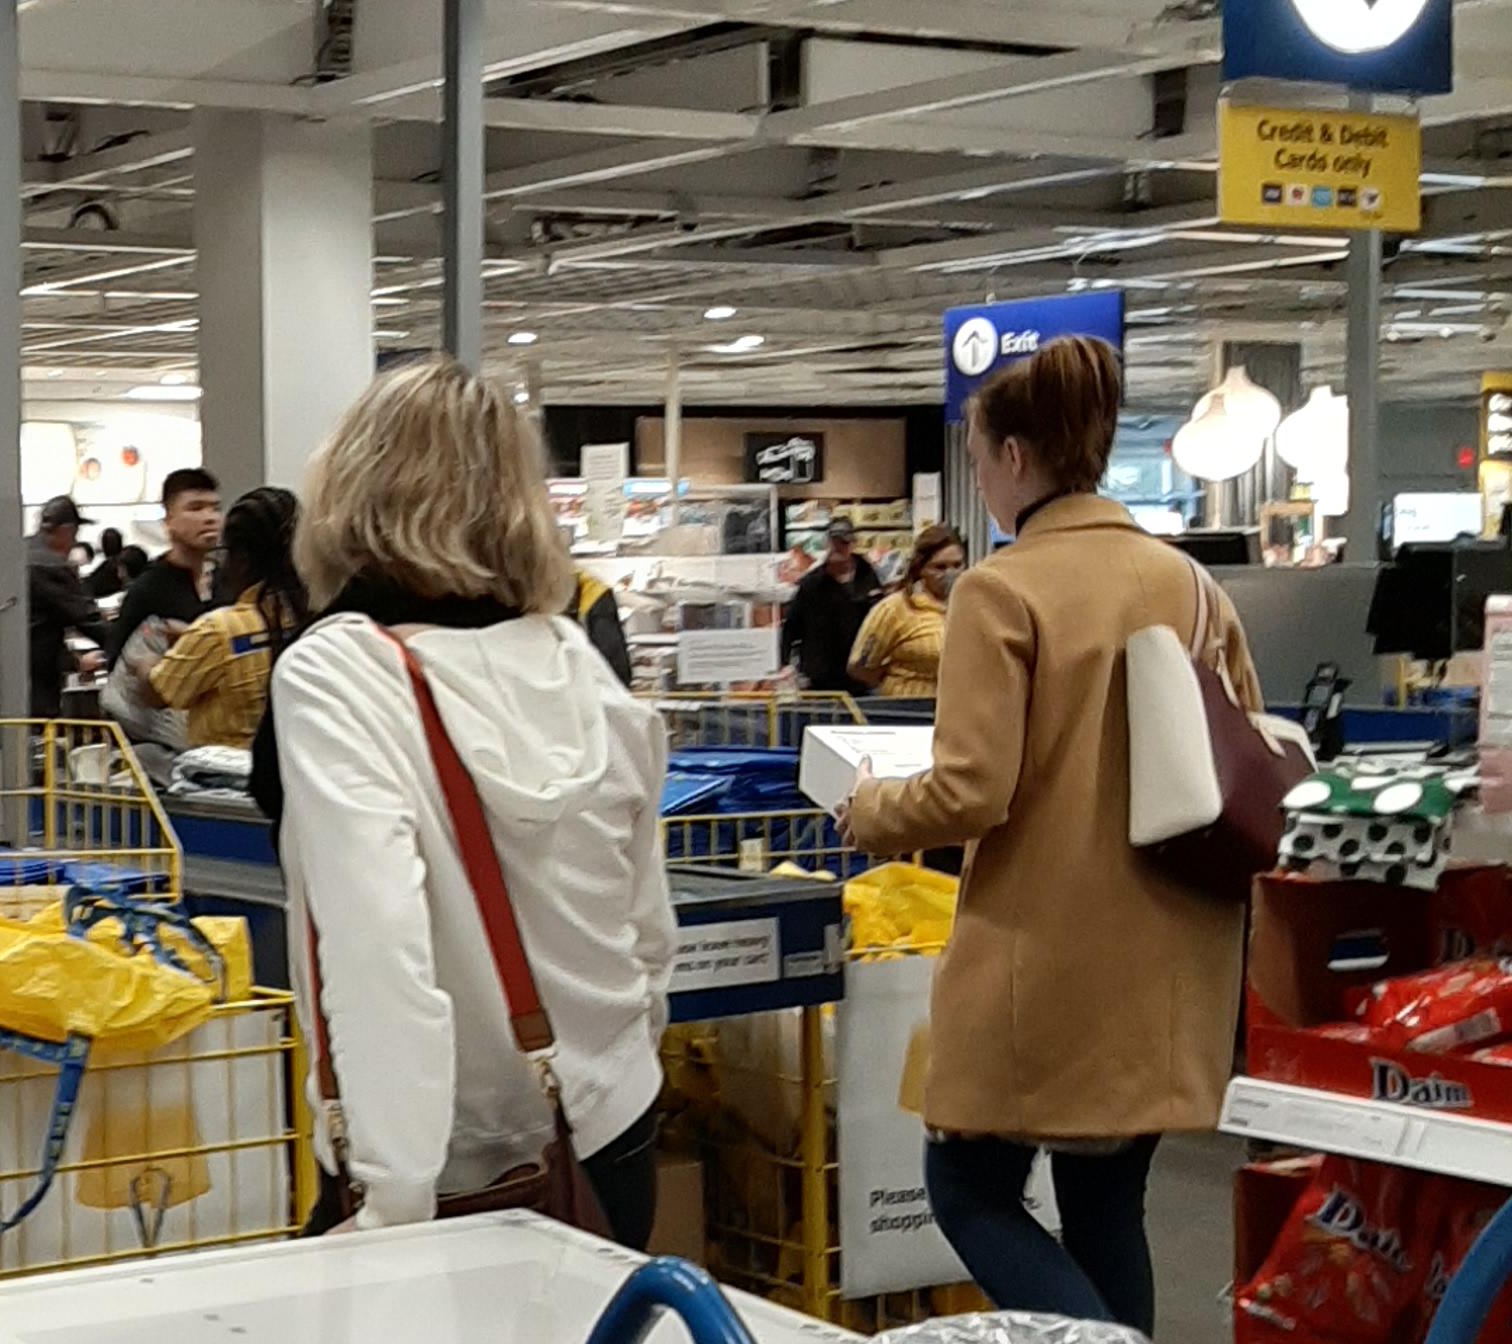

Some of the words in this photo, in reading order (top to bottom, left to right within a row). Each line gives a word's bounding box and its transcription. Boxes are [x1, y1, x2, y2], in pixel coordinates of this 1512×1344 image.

[1257, 119, 1315, 144] Credit
[1320, 122, 1334, 144] &
[1340, 124, 1389, 149] Debit
[1274, 147, 1328, 173] Cards
[1332, 152, 1372, 178] only
[1001, 328, 1040, 355] Exit
[1370, 1056, 1474, 1108] Daim
[869, 1187, 926, 1208] Please
[869, 1209, 936, 1235] shoppin
